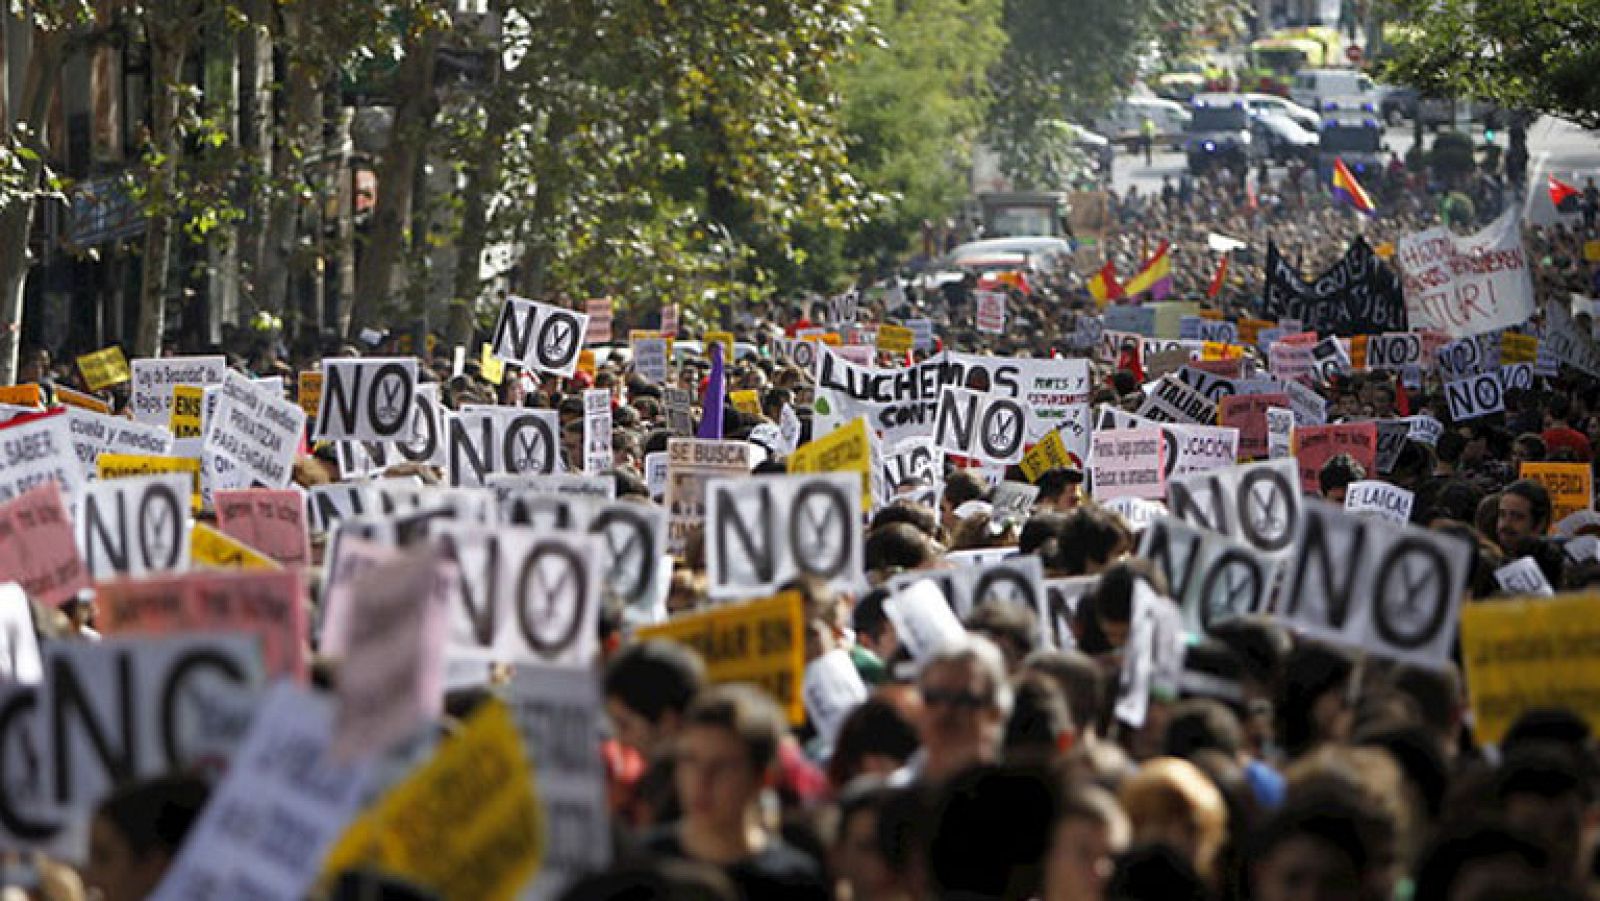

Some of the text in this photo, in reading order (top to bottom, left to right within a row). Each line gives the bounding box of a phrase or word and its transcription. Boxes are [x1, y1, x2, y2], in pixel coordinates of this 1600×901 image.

[493, 299, 580, 368] NO
[320, 363, 413, 436] NO
[820, 351, 1020, 402] LUCHEMOS
[1448, 376, 1499, 417] NO
[451, 415, 555, 488] NO
[671, 442, 749, 465] SE BUSCA
[936, 388, 1025, 458] NO
[84, 483, 183, 578] NO
[715, 481, 852, 586] NO
[1170, 468, 1298, 552] NO
[1147, 519, 1262, 634] NO
[1288, 512, 1451, 648] NO
